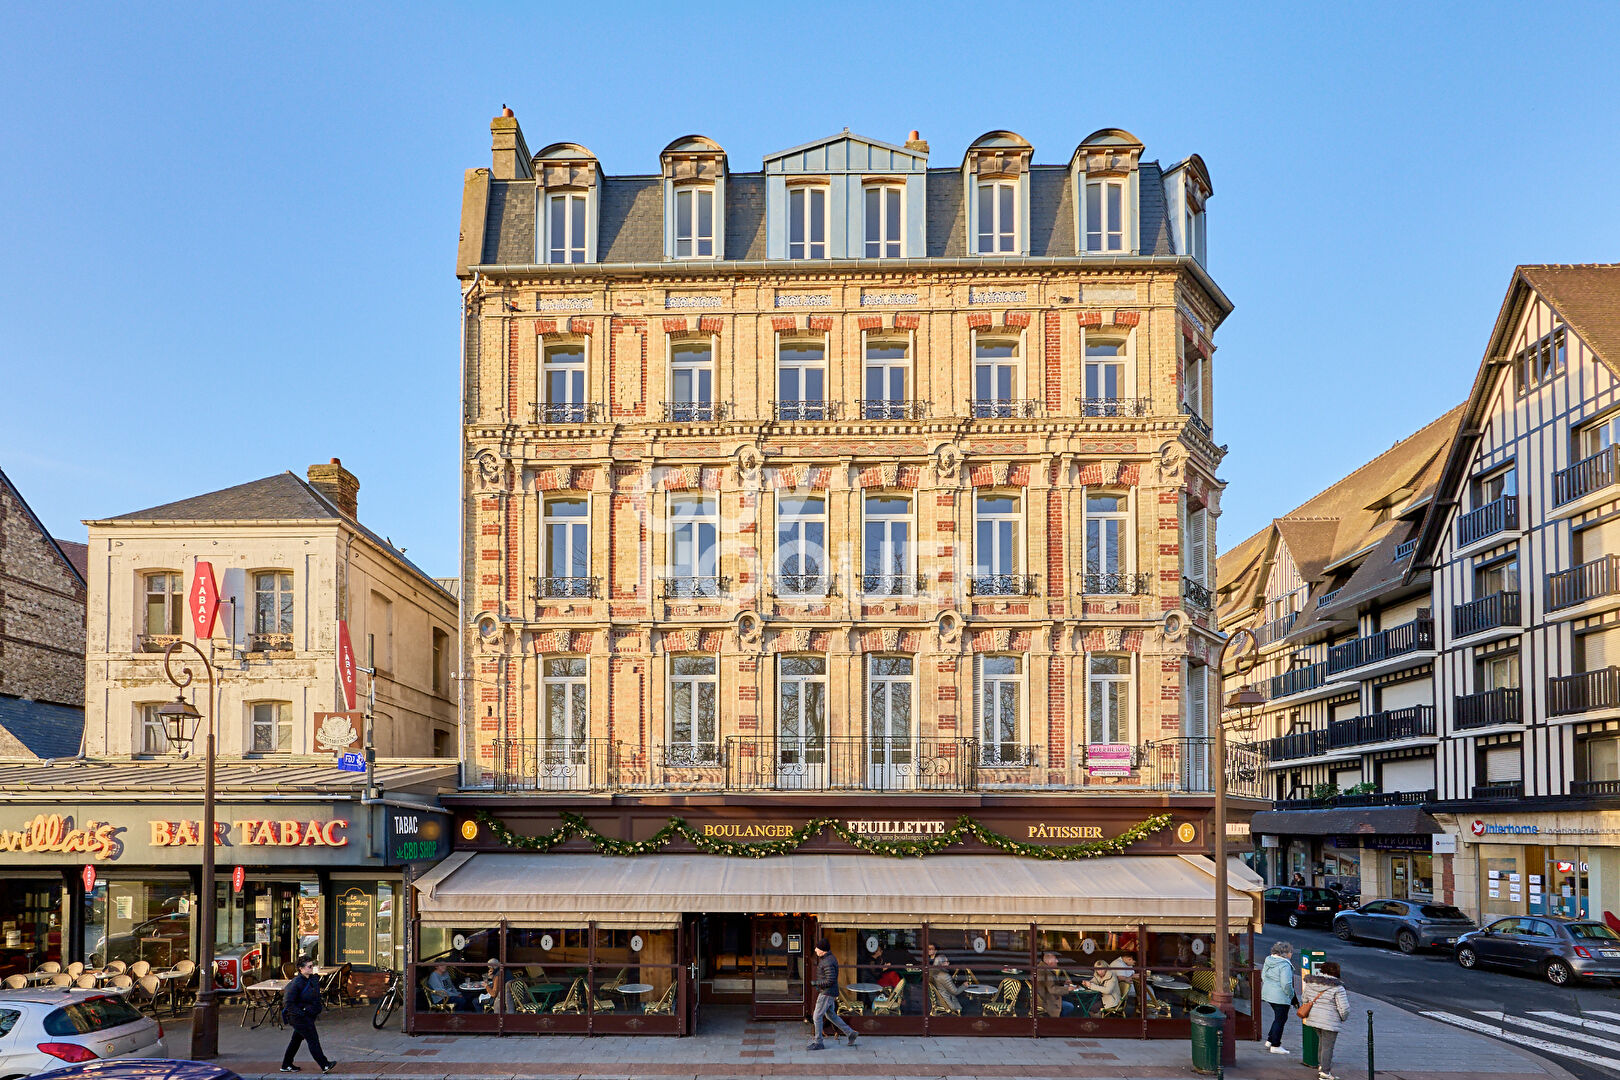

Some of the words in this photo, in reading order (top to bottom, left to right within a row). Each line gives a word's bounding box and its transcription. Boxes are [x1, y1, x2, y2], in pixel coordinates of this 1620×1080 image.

[198, 576, 207, 623] TABAC
[343, 645, 352, 683] TABAC
[345, 754, 356, 763] FDJ
[234, 819, 348, 846] TABAC
[394, 816, 418, 834] TABAC
[703, 824, 794, 837] BOULANGER
[847, 821, 945, 834] FEUILLETTE
[1028, 823, 1104, 839] PÂTISSIER
[0, 813, 114, 860] villais
[403, 841, 418, 860] CBD
[420, 841, 437, 858] SHOP
[1303, 956, 1309, 966] P
